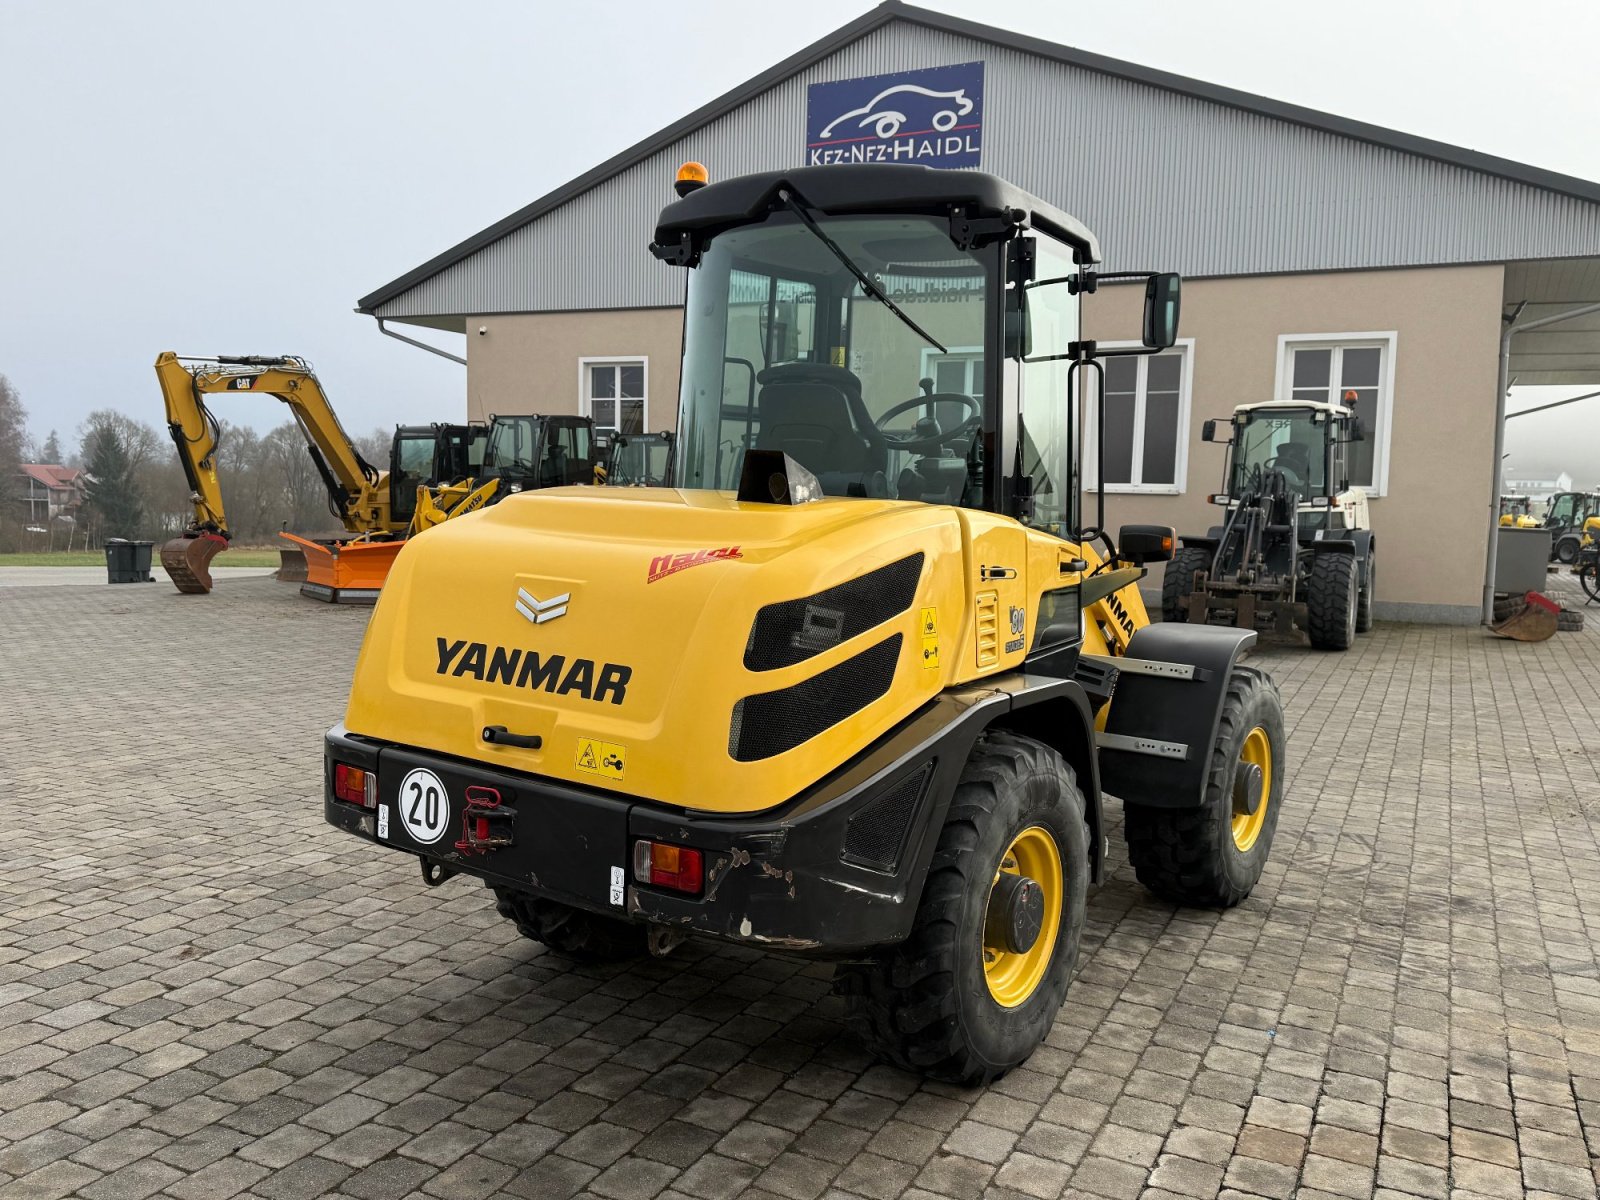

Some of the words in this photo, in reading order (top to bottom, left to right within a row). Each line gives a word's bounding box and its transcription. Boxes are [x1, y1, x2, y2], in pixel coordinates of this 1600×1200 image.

[236, 378, 251, 389] CAT
[1104, 592, 1138, 639] NMA
[436, 637, 633, 706] YANMAR
[408, 781, 440, 831] 20
